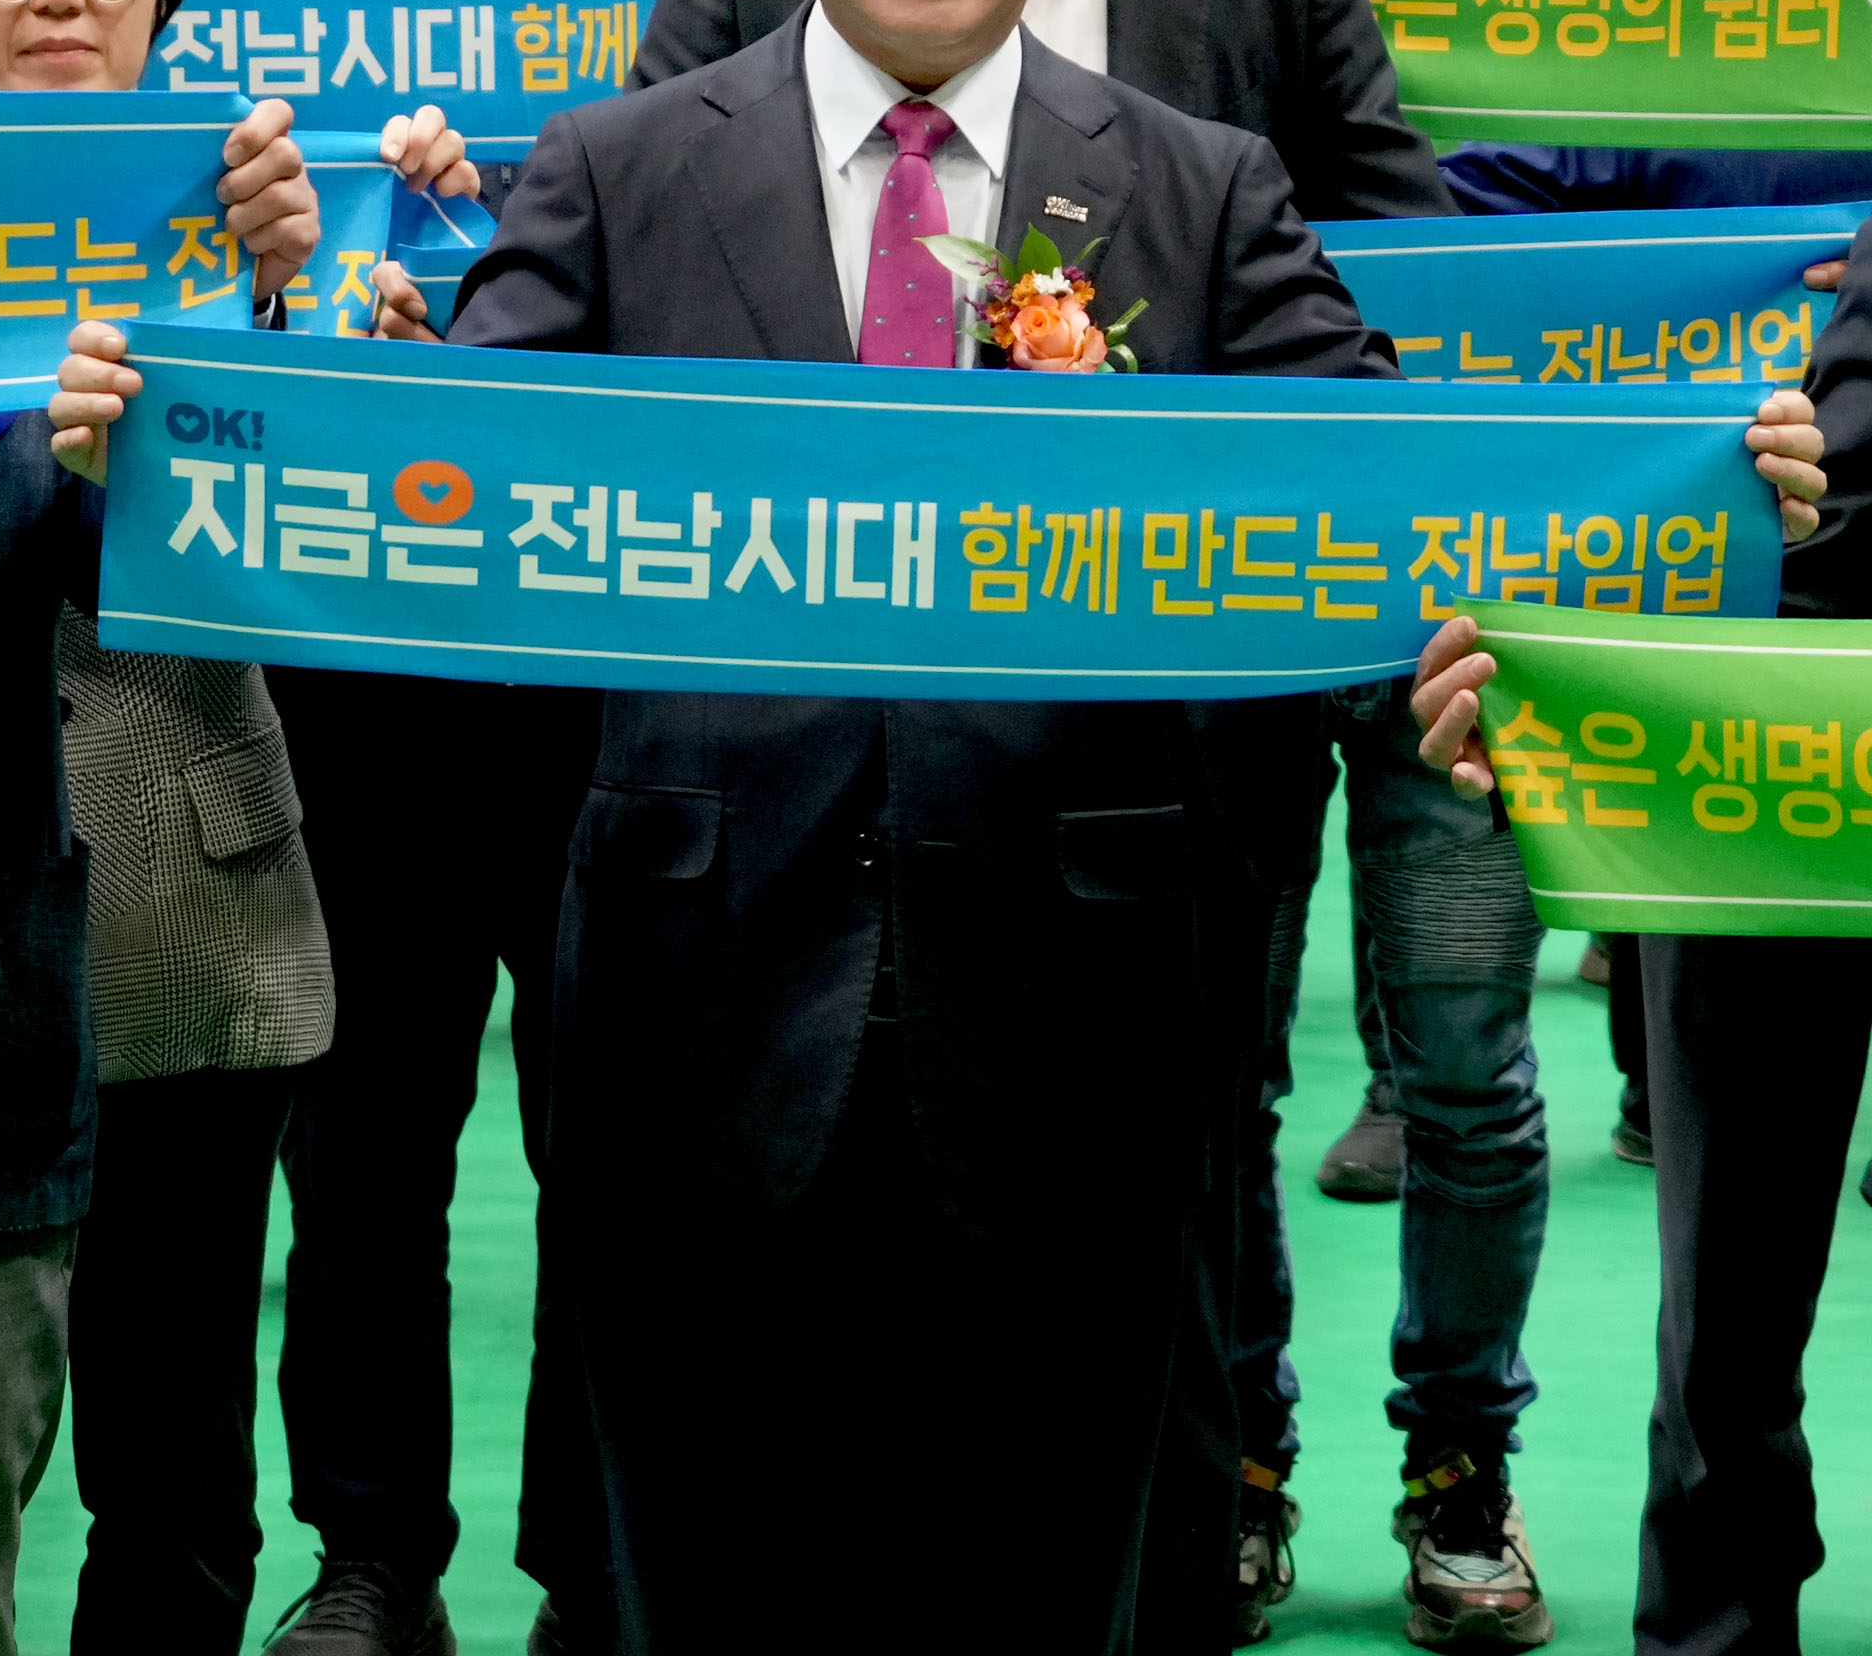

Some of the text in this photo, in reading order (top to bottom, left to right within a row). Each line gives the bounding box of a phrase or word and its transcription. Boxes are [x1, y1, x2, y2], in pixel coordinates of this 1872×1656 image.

[161, 3, 638, 96] 전남시대 함께
[164, 400, 265, 452] OK!
[168, 456, 1729, 620] 지금은 전남시대 함께 만드는 전남임업
[1494, 701, 1660, 834] 숲은
